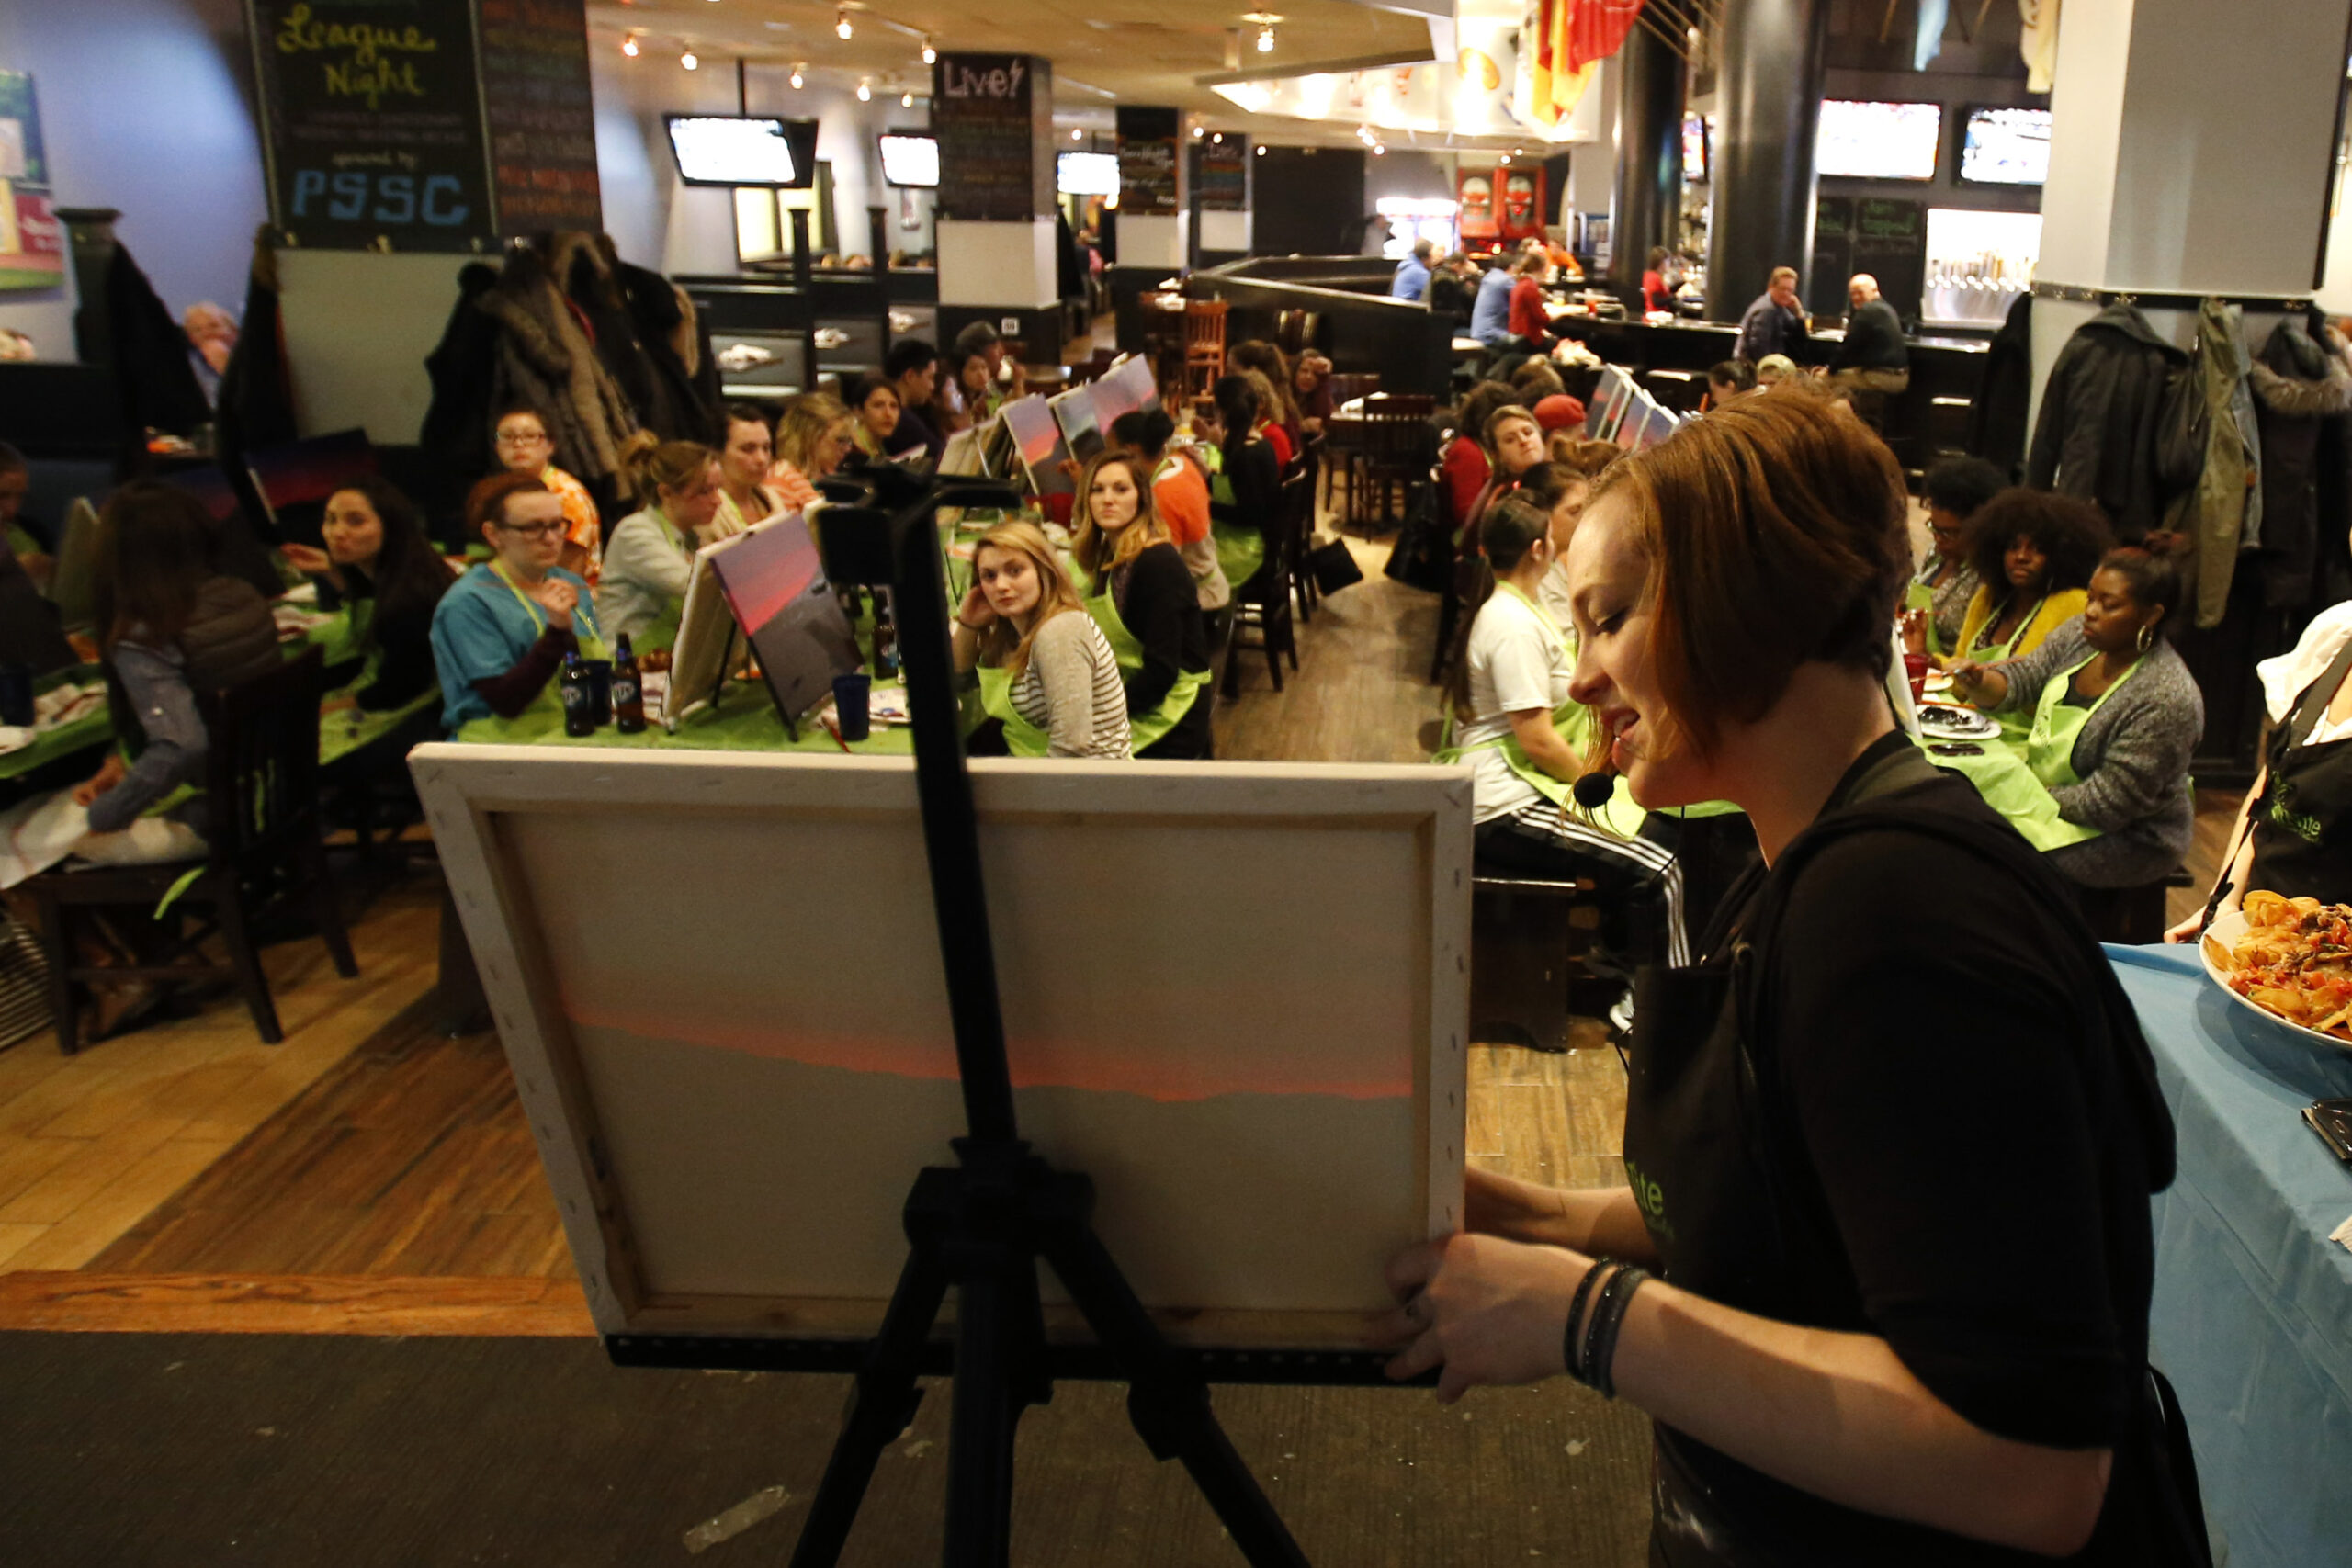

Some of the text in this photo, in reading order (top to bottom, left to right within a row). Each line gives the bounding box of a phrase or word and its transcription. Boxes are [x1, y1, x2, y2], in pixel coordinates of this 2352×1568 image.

[277, 3, 436, 66] League
[324, 58, 424, 109] Night
[291, 169, 470, 227] PSSC
